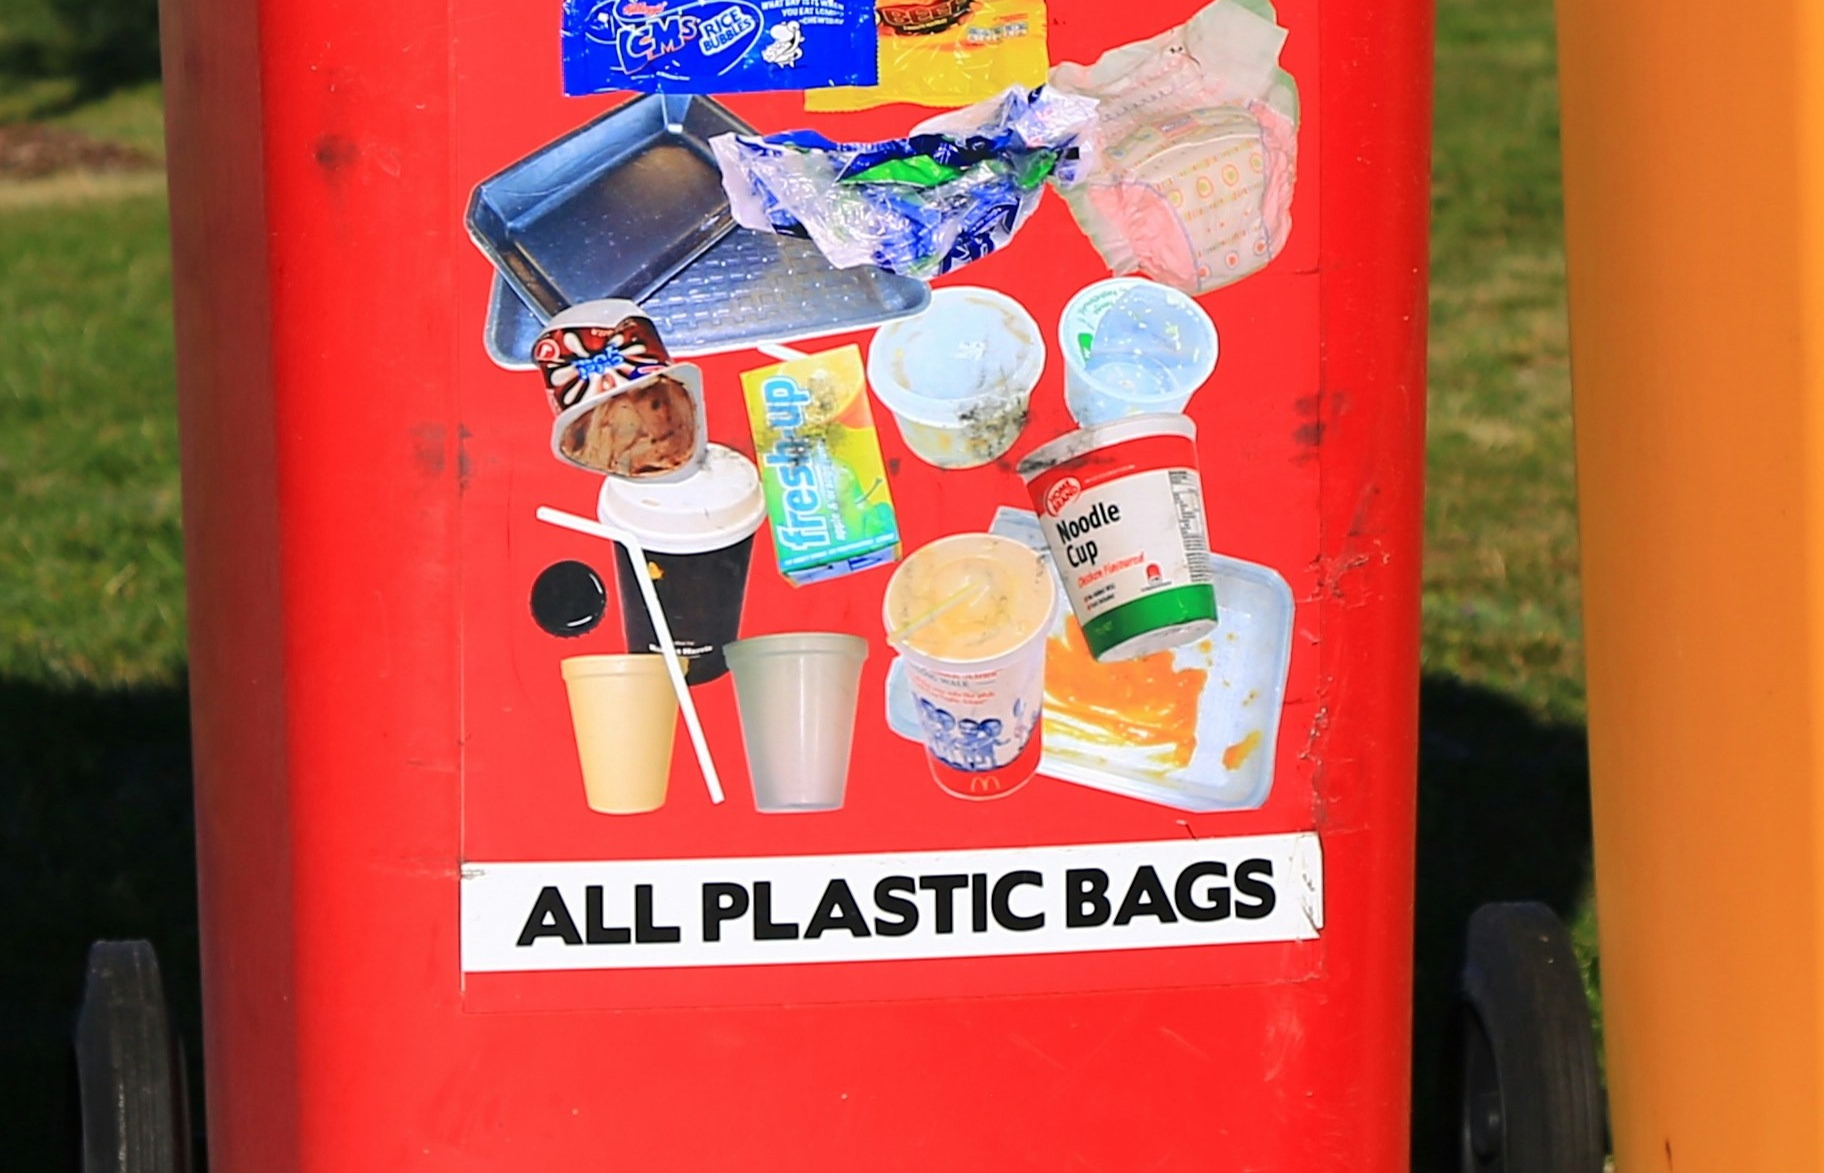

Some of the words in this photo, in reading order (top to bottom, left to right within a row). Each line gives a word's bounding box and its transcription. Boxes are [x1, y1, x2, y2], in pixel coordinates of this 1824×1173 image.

[761, 0, 784, 11] WHAT
[702, 18, 753, 52] BUBBLES
[704, 9, 742, 37] RICE
[1056, 502, 1121, 545] Noodle
[1066, 539, 1099, 569] Cup
[515, 884, 681, 947] ALL
[702, 869, 1048, 942] PLASTIC
[1065, 858, 1277, 929] BAGS
